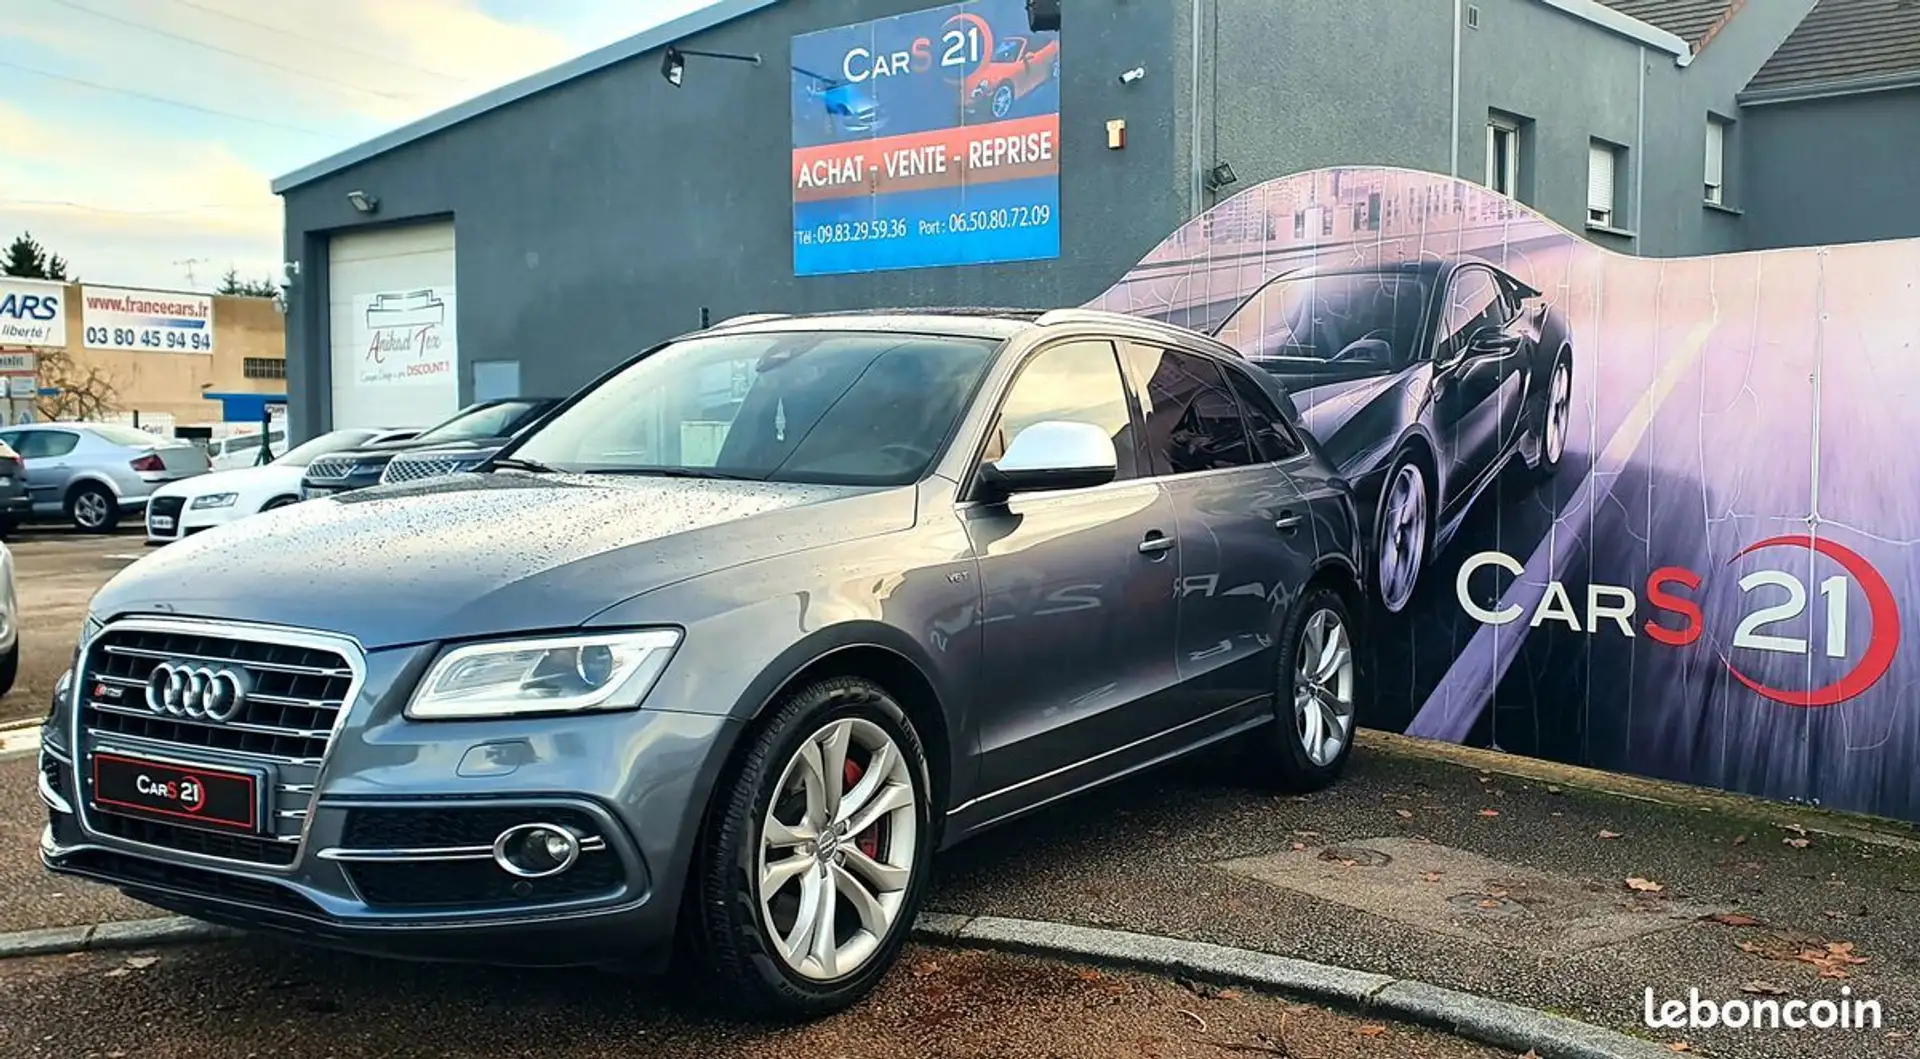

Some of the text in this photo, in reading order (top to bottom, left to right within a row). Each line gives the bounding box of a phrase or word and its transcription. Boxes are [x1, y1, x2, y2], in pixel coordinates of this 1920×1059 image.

[940, 27, 978, 68] 21
[797, 155, 864, 189] ACHAT
[883, 144, 946, 179] VENTE
[968, 130, 1053, 170] REPRISE
[948, 204, 1050, 233] 06.50.80.72.09
[86, 295, 209, 318] www.francecars.fr
[86, 326, 211, 351] 03 80 45 94 94
[1732, 569, 1850, 659] 21
[180, 781, 199, 802] 21
